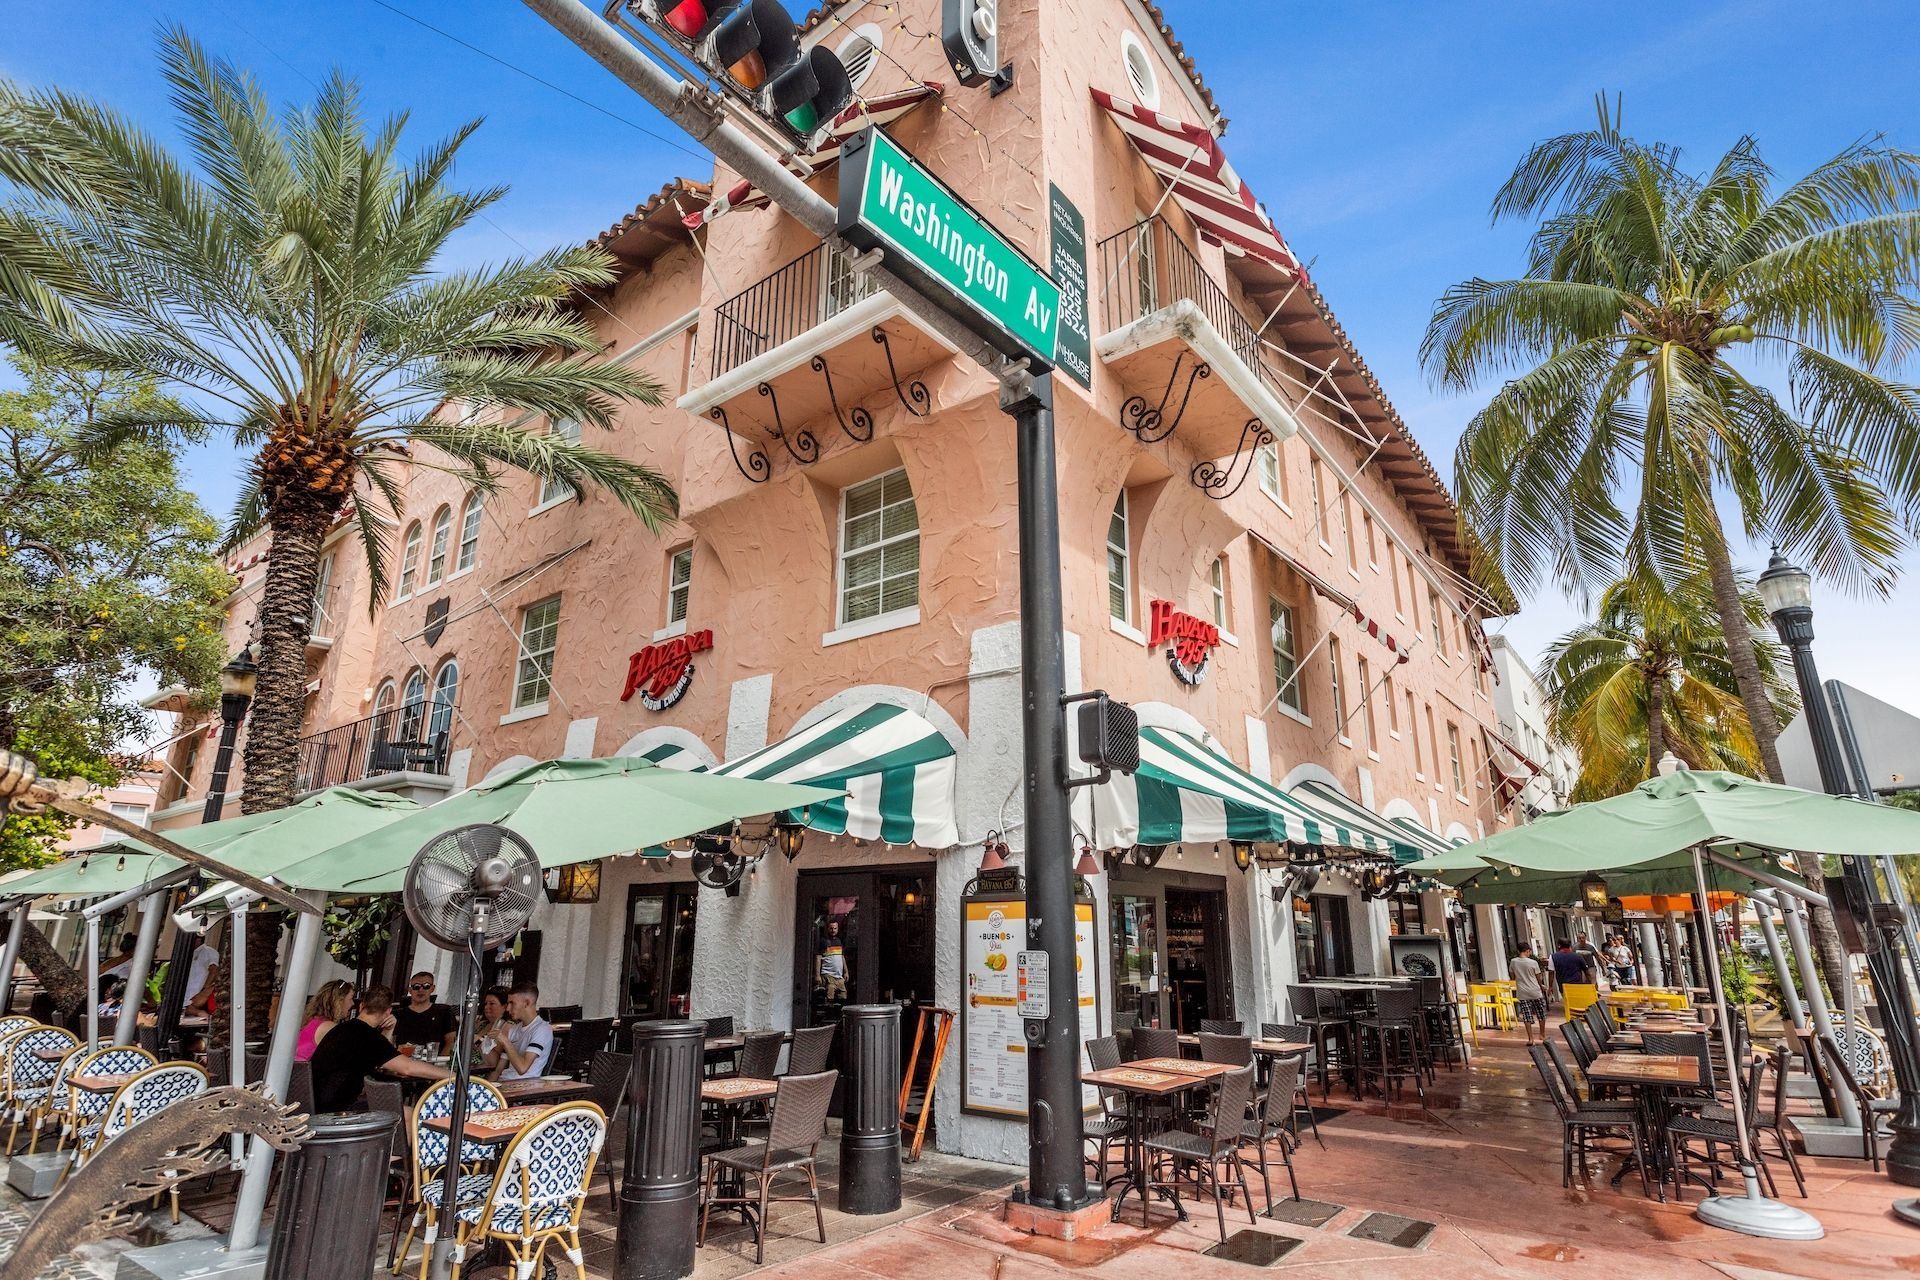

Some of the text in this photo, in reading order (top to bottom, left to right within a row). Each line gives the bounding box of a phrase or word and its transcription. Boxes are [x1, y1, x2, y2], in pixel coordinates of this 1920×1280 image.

[969, 38, 991, 67] HOTEL
[1053, 199, 1074, 227] RETAIL
[1053, 209, 1083, 246] INQUIRIES
[878, 159, 1051, 334] Washington Av
[1056, 243, 1082, 275] JARED
[1054, 254, 1086, 291] ROBINS
[1058, 271, 1082, 306] 305
[620, 629, 713, 702] HAVANA
[982, 931, 1011, 941] BUENOS
